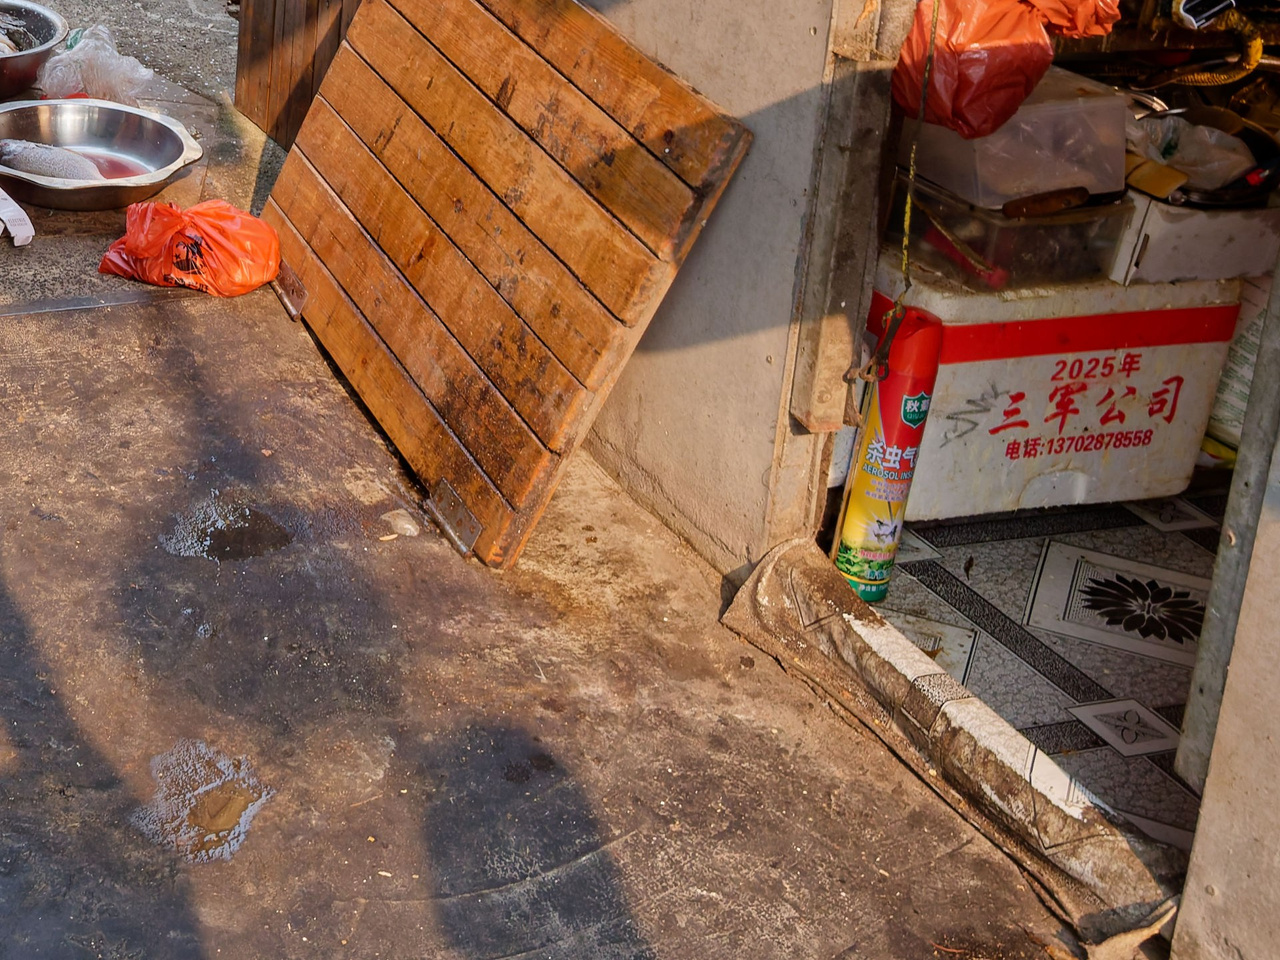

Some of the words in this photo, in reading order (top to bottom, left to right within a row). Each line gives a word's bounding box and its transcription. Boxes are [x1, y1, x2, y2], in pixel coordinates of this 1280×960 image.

[1050, 352, 1143, 381] 2025年
[988, 375, 1185, 435] 三军公司
[1005, 429, 1154, 460] 电话:13702878558
[863, 463, 899, 480] AEROSOL
